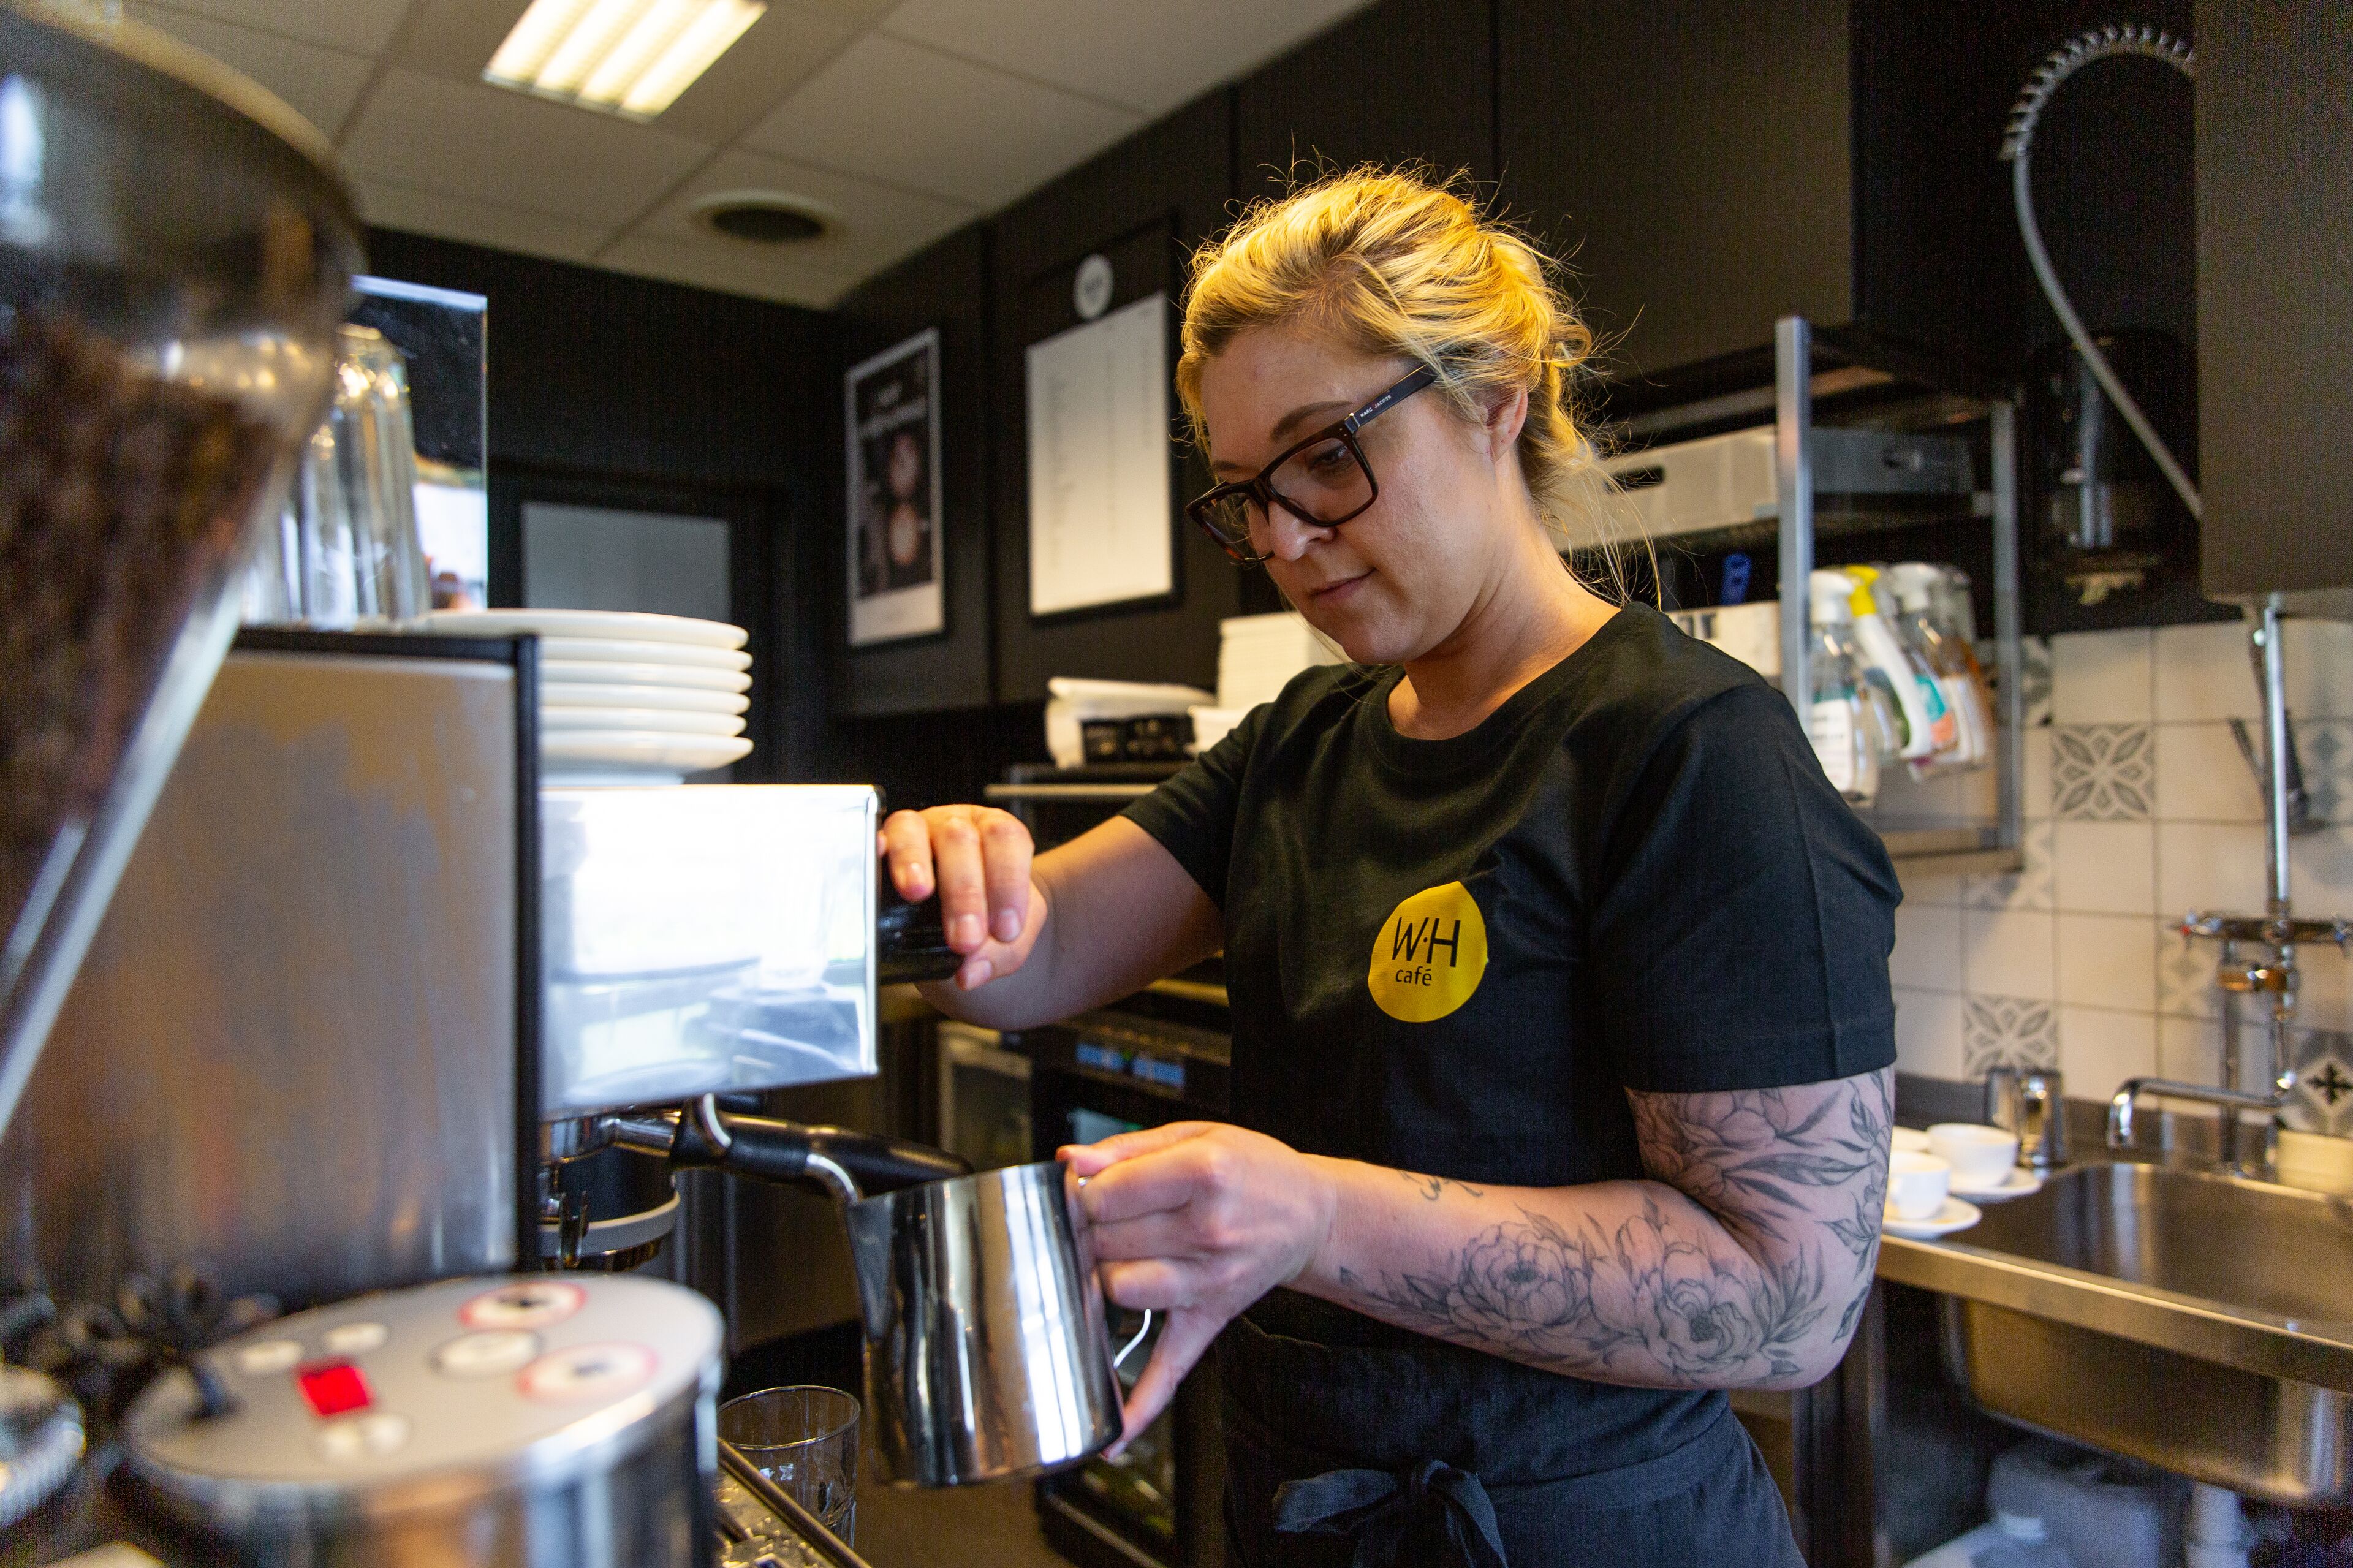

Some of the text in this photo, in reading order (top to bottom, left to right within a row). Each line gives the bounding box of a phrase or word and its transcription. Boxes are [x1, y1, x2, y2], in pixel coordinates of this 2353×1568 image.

[1360, 395, 1392, 418] MARC JACOBS
[1395, 966, 1433, 987] café
